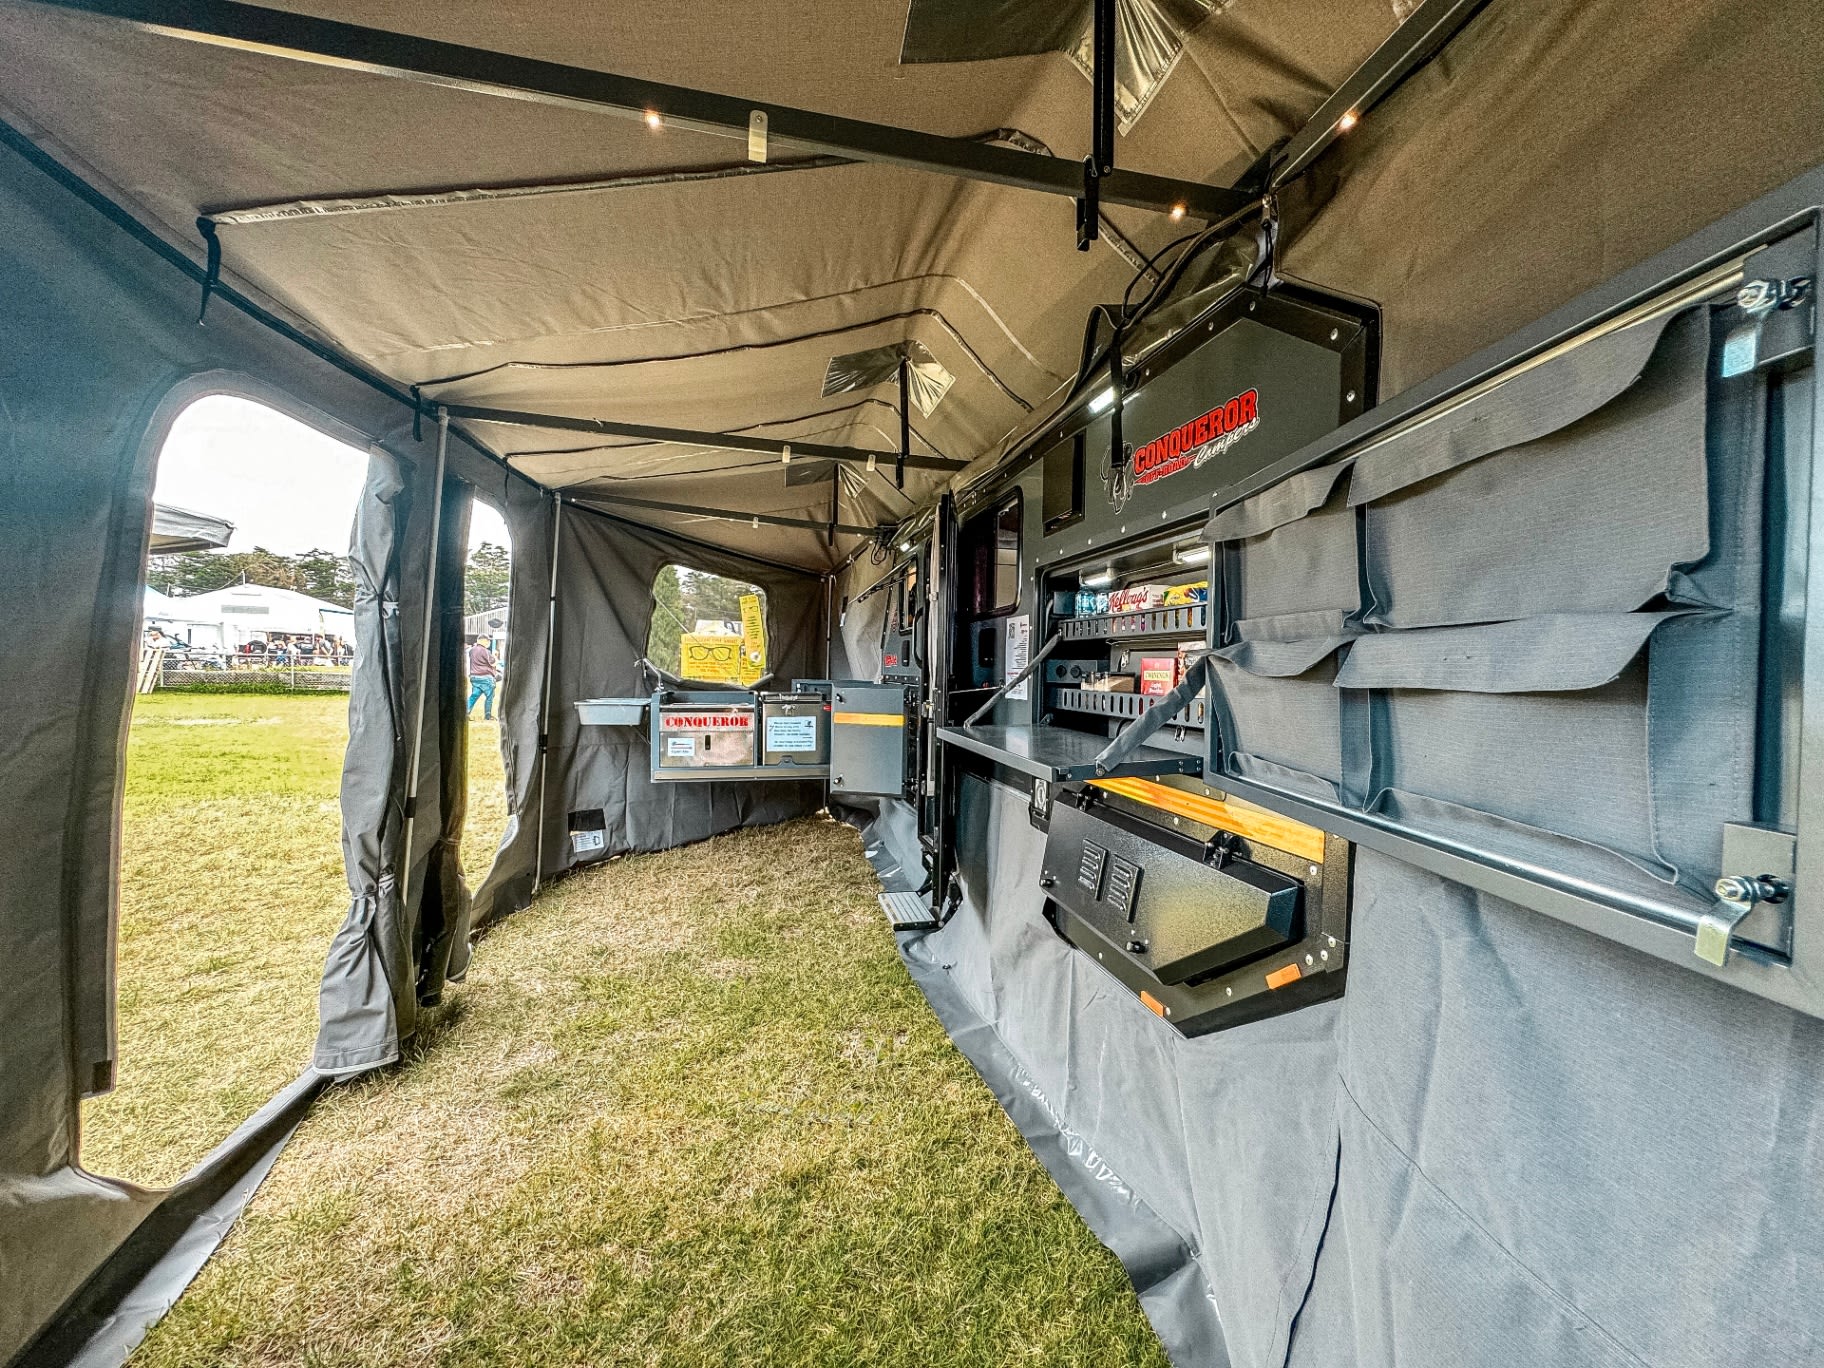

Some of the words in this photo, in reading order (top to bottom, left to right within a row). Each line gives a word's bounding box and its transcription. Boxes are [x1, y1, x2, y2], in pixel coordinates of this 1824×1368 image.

[1133, 388, 1258, 475] CONQUEROR
[1193, 416, 1261, 469] Campers
[1109, 587, 1149, 612] Kellogg's
[665, 716, 749, 728] CONQUEROR
